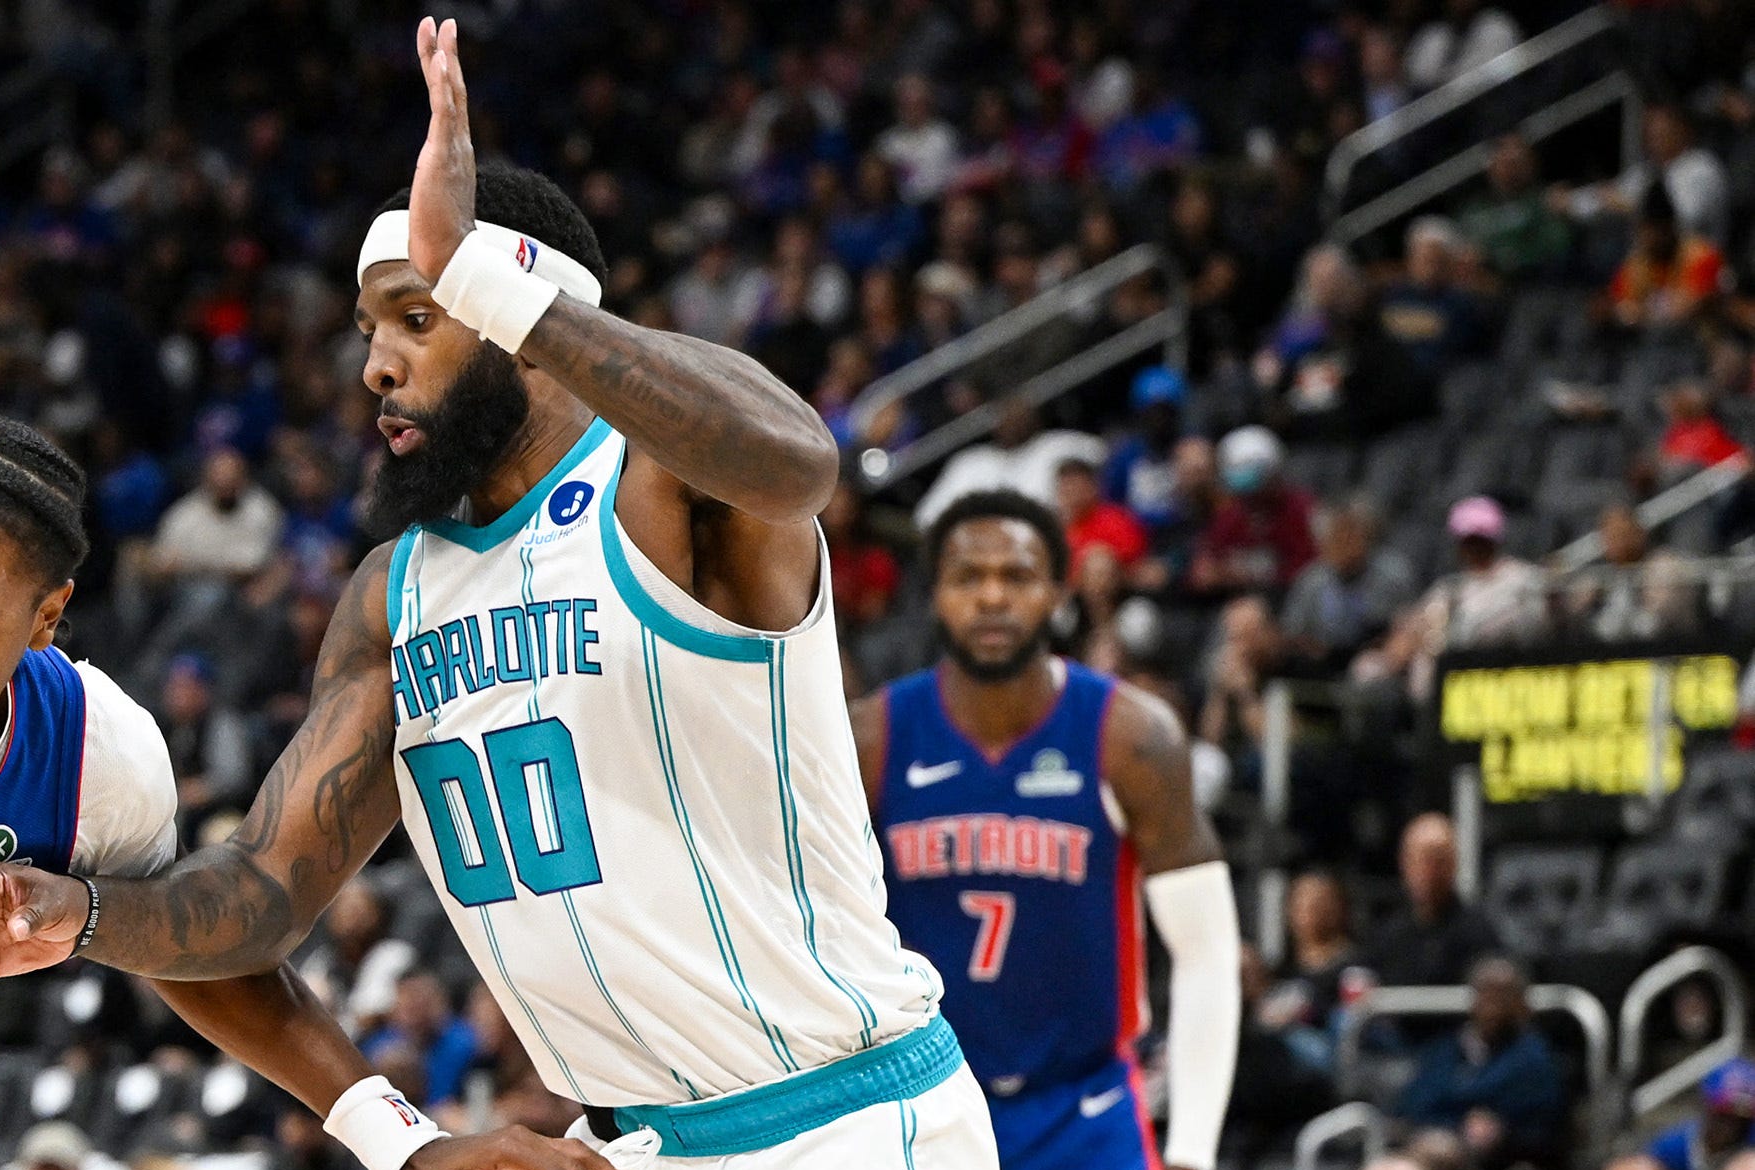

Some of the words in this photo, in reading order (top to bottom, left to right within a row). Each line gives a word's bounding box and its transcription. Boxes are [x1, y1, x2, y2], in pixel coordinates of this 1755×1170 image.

[391, 597, 603, 727] HARLOTTE
[1573, 654, 1738, 730] BETER
[399, 716, 603, 908] 00
[887, 811, 1094, 886] DETROIT
[958, 889, 1017, 983] 7
